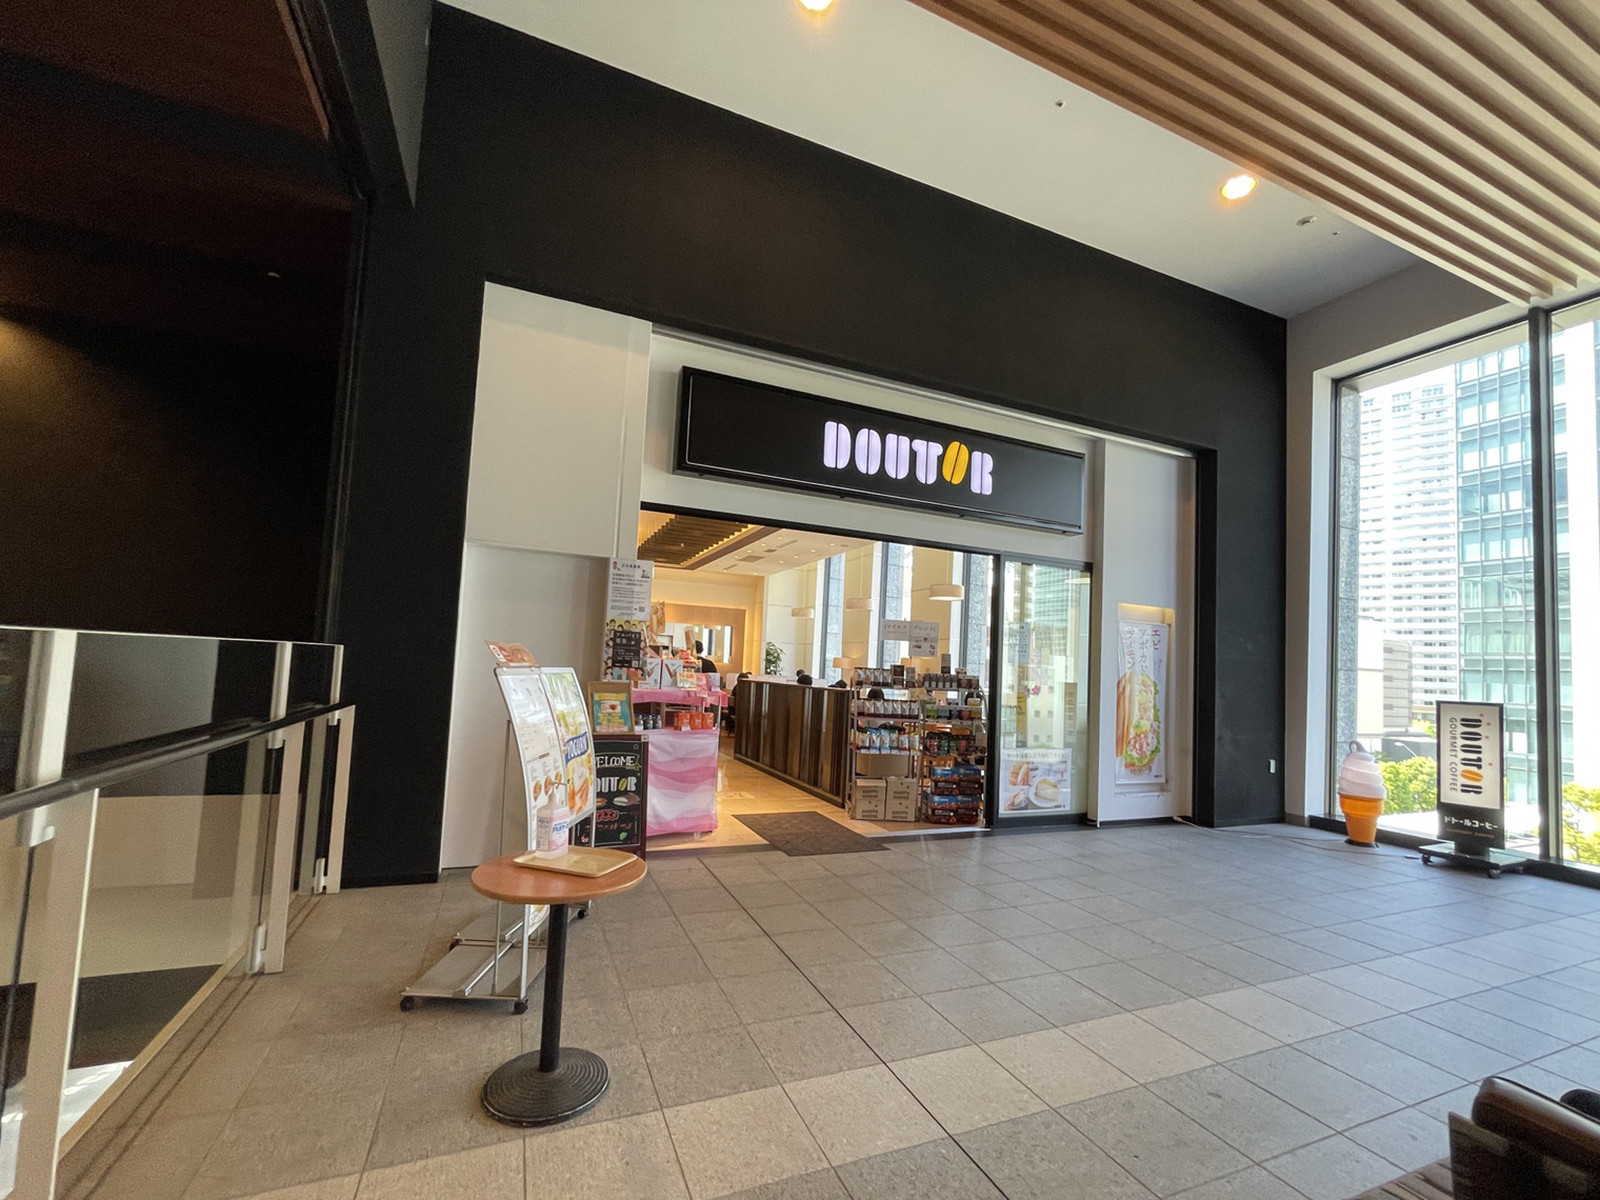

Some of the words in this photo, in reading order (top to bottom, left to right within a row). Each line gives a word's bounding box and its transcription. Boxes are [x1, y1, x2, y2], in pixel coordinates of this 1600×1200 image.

[823, 420, 994, 496] DOUTOR
[1125, 626, 1136, 670] サーモン
[1137, 628, 1148, 673] アボカド
[1152, 629, 1161, 651] エビ
[1449, 717, 1458, 758] GOURMET
[1460, 717, 1484, 795] DOUTOR
[595, 755, 636, 768] ELCOME
[1449, 762, 1458, 792] COFFEE
[1444, 816, 1499, 830] ドトールコーヒー
